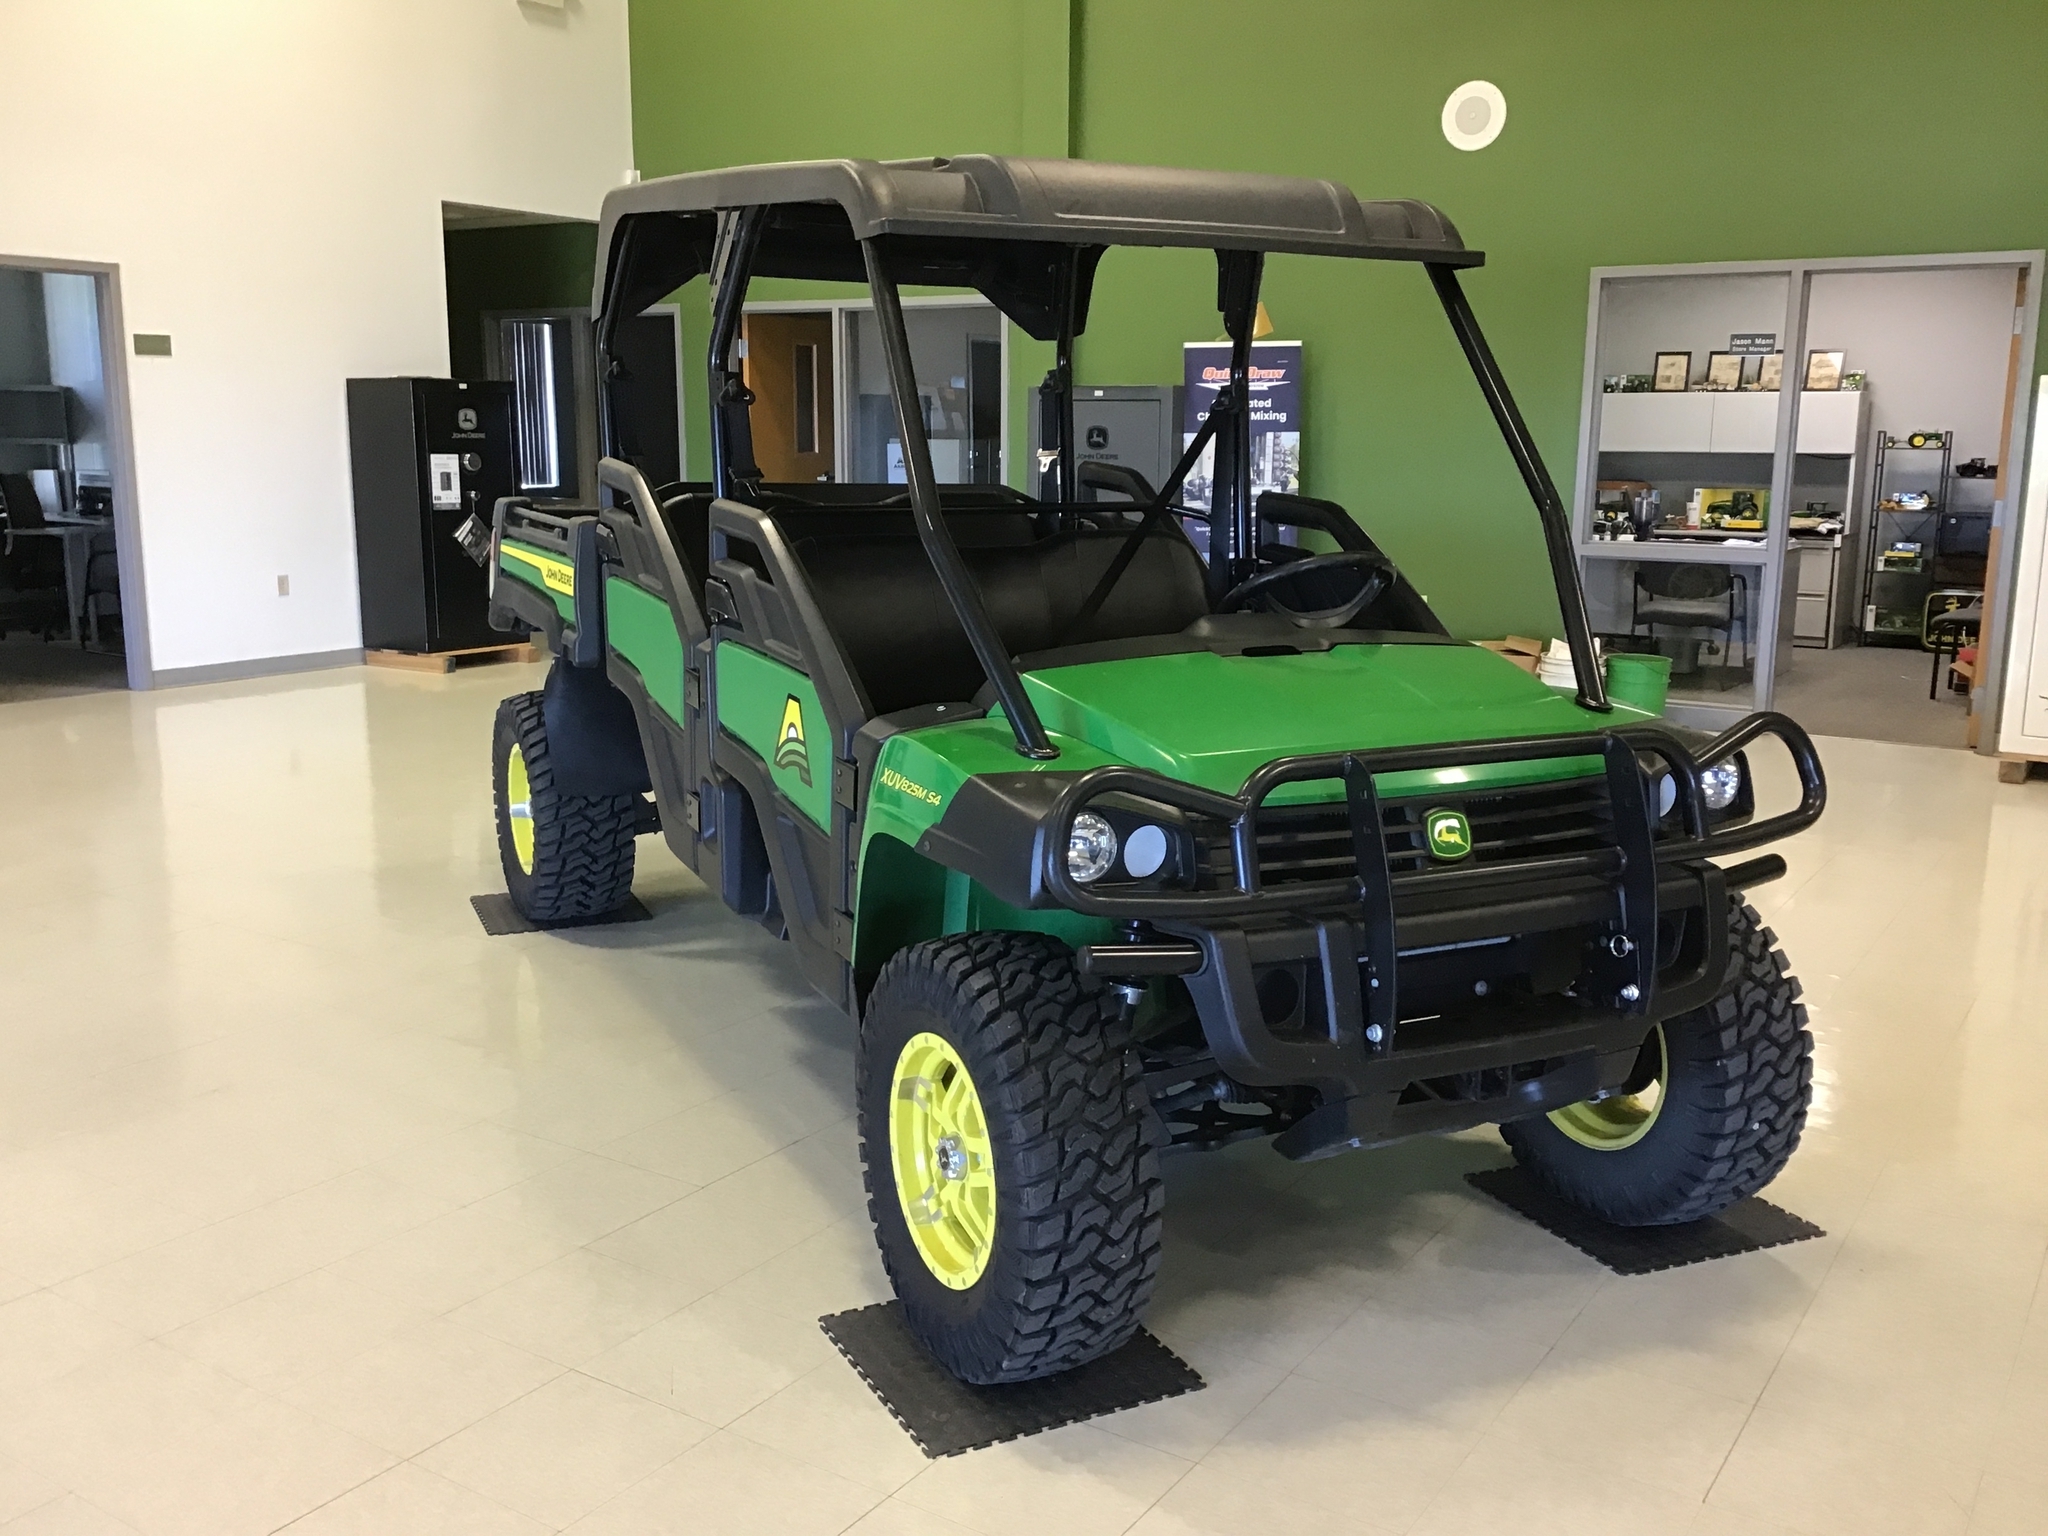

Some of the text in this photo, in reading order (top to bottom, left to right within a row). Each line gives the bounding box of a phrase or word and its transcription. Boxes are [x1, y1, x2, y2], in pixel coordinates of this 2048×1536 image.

[1202, 366, 1286, 381] QuiDraw
[1250, 410, 1287, 423] Mixing
[451, 431, 486, 439] JOHN DEERE
[1076, 452, 1119, 460] JOHN DEERE
[546, 565, 573, 587] JOHN DEERE
[880, 767, 942, 807] XUV825M S4
